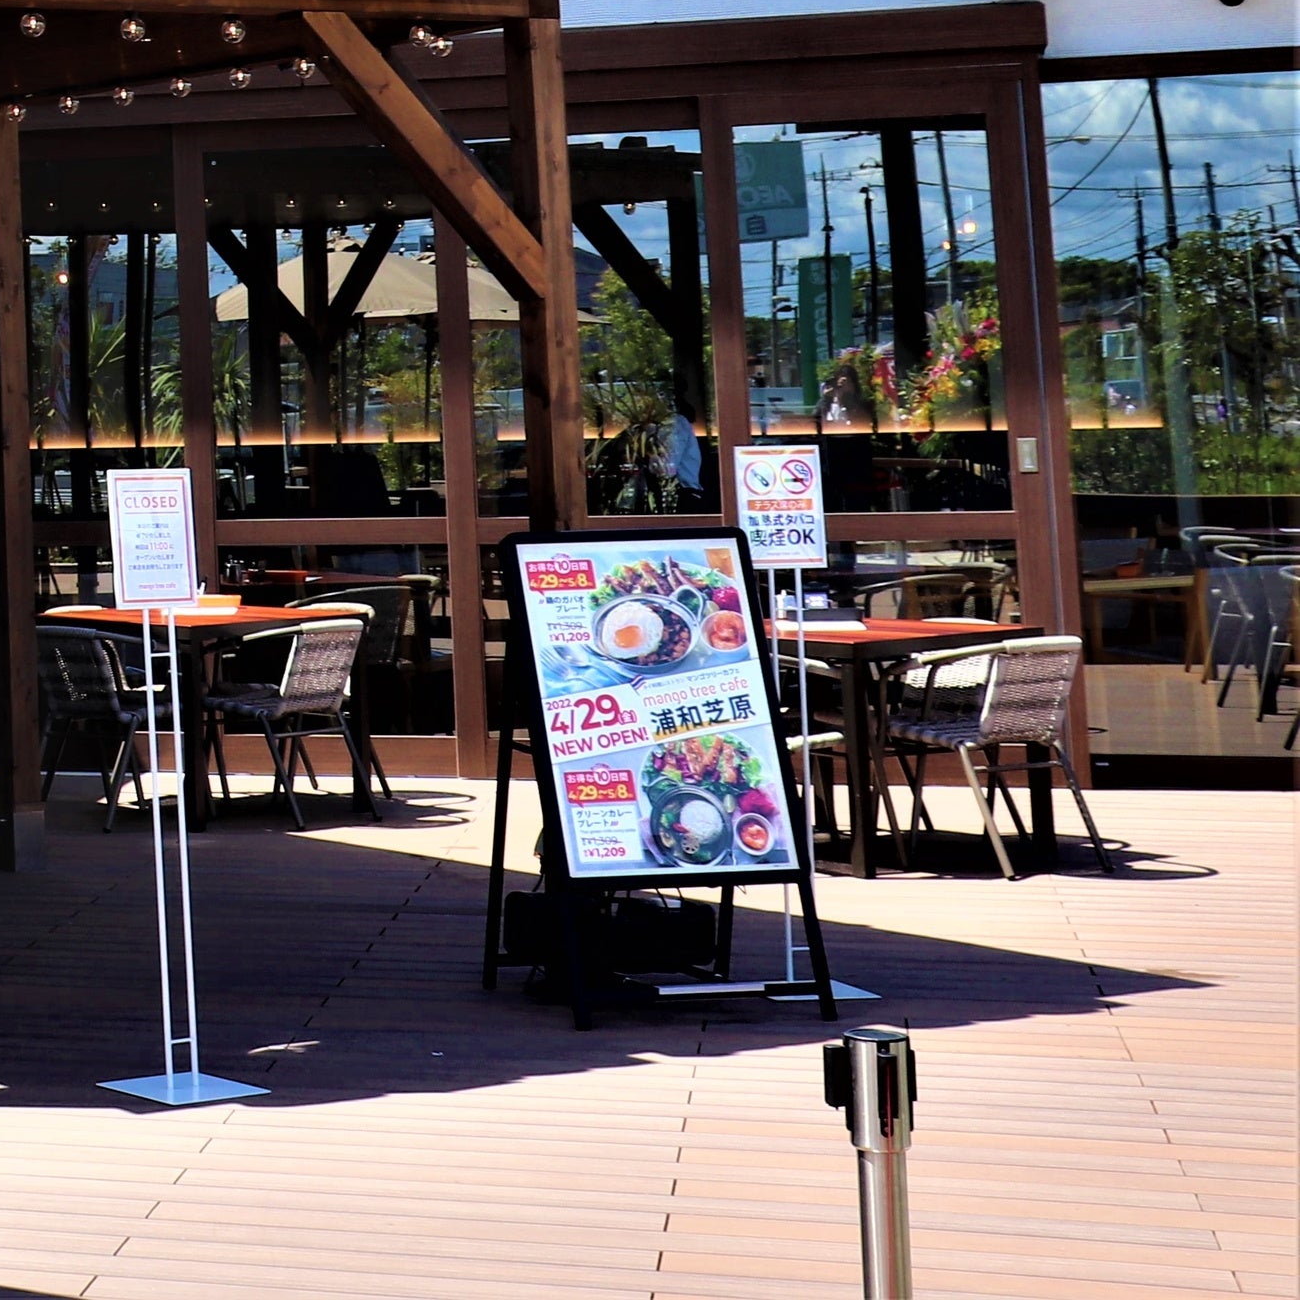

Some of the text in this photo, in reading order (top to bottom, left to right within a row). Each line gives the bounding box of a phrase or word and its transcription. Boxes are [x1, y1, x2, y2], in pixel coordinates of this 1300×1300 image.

[124, 496, 178, 508] CLOSED
[750, 528, 816, 547] 喫煙OK
[643, 676, 749, 707] mango tree cafe
[546, 698, 573, 711] 2022
[650, 694, 757, 736] 浦和芝原
[552, 726, 650, 758] NEW OPEN!
[576, 809, 633, 818] グリーンカレー
[578, 819, 610, 828] プレート
